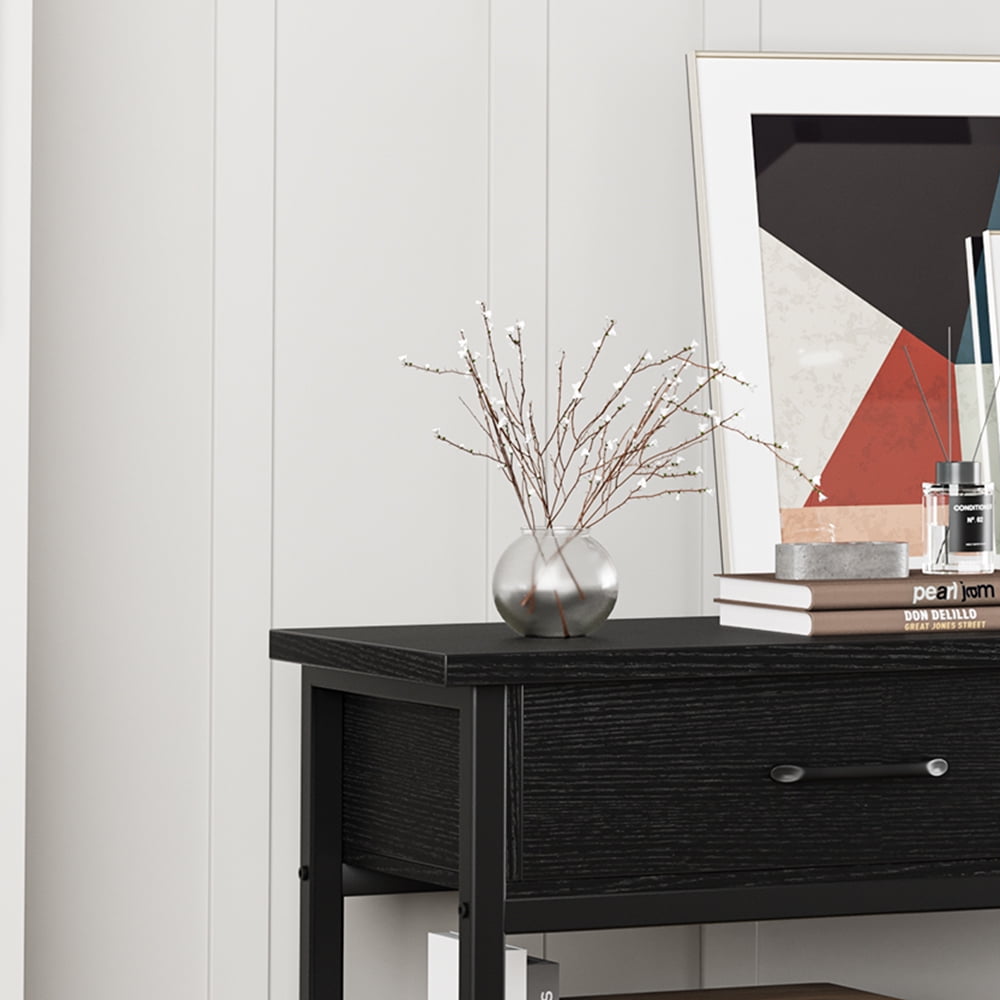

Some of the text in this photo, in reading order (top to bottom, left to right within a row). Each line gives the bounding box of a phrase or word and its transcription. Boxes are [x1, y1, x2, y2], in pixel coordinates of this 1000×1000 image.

[912, 582, 957, 604] pearl
[904, 608, 977, 621] DON DELILLO
[904, 620, 986, 631] GREAT JONES STREET
